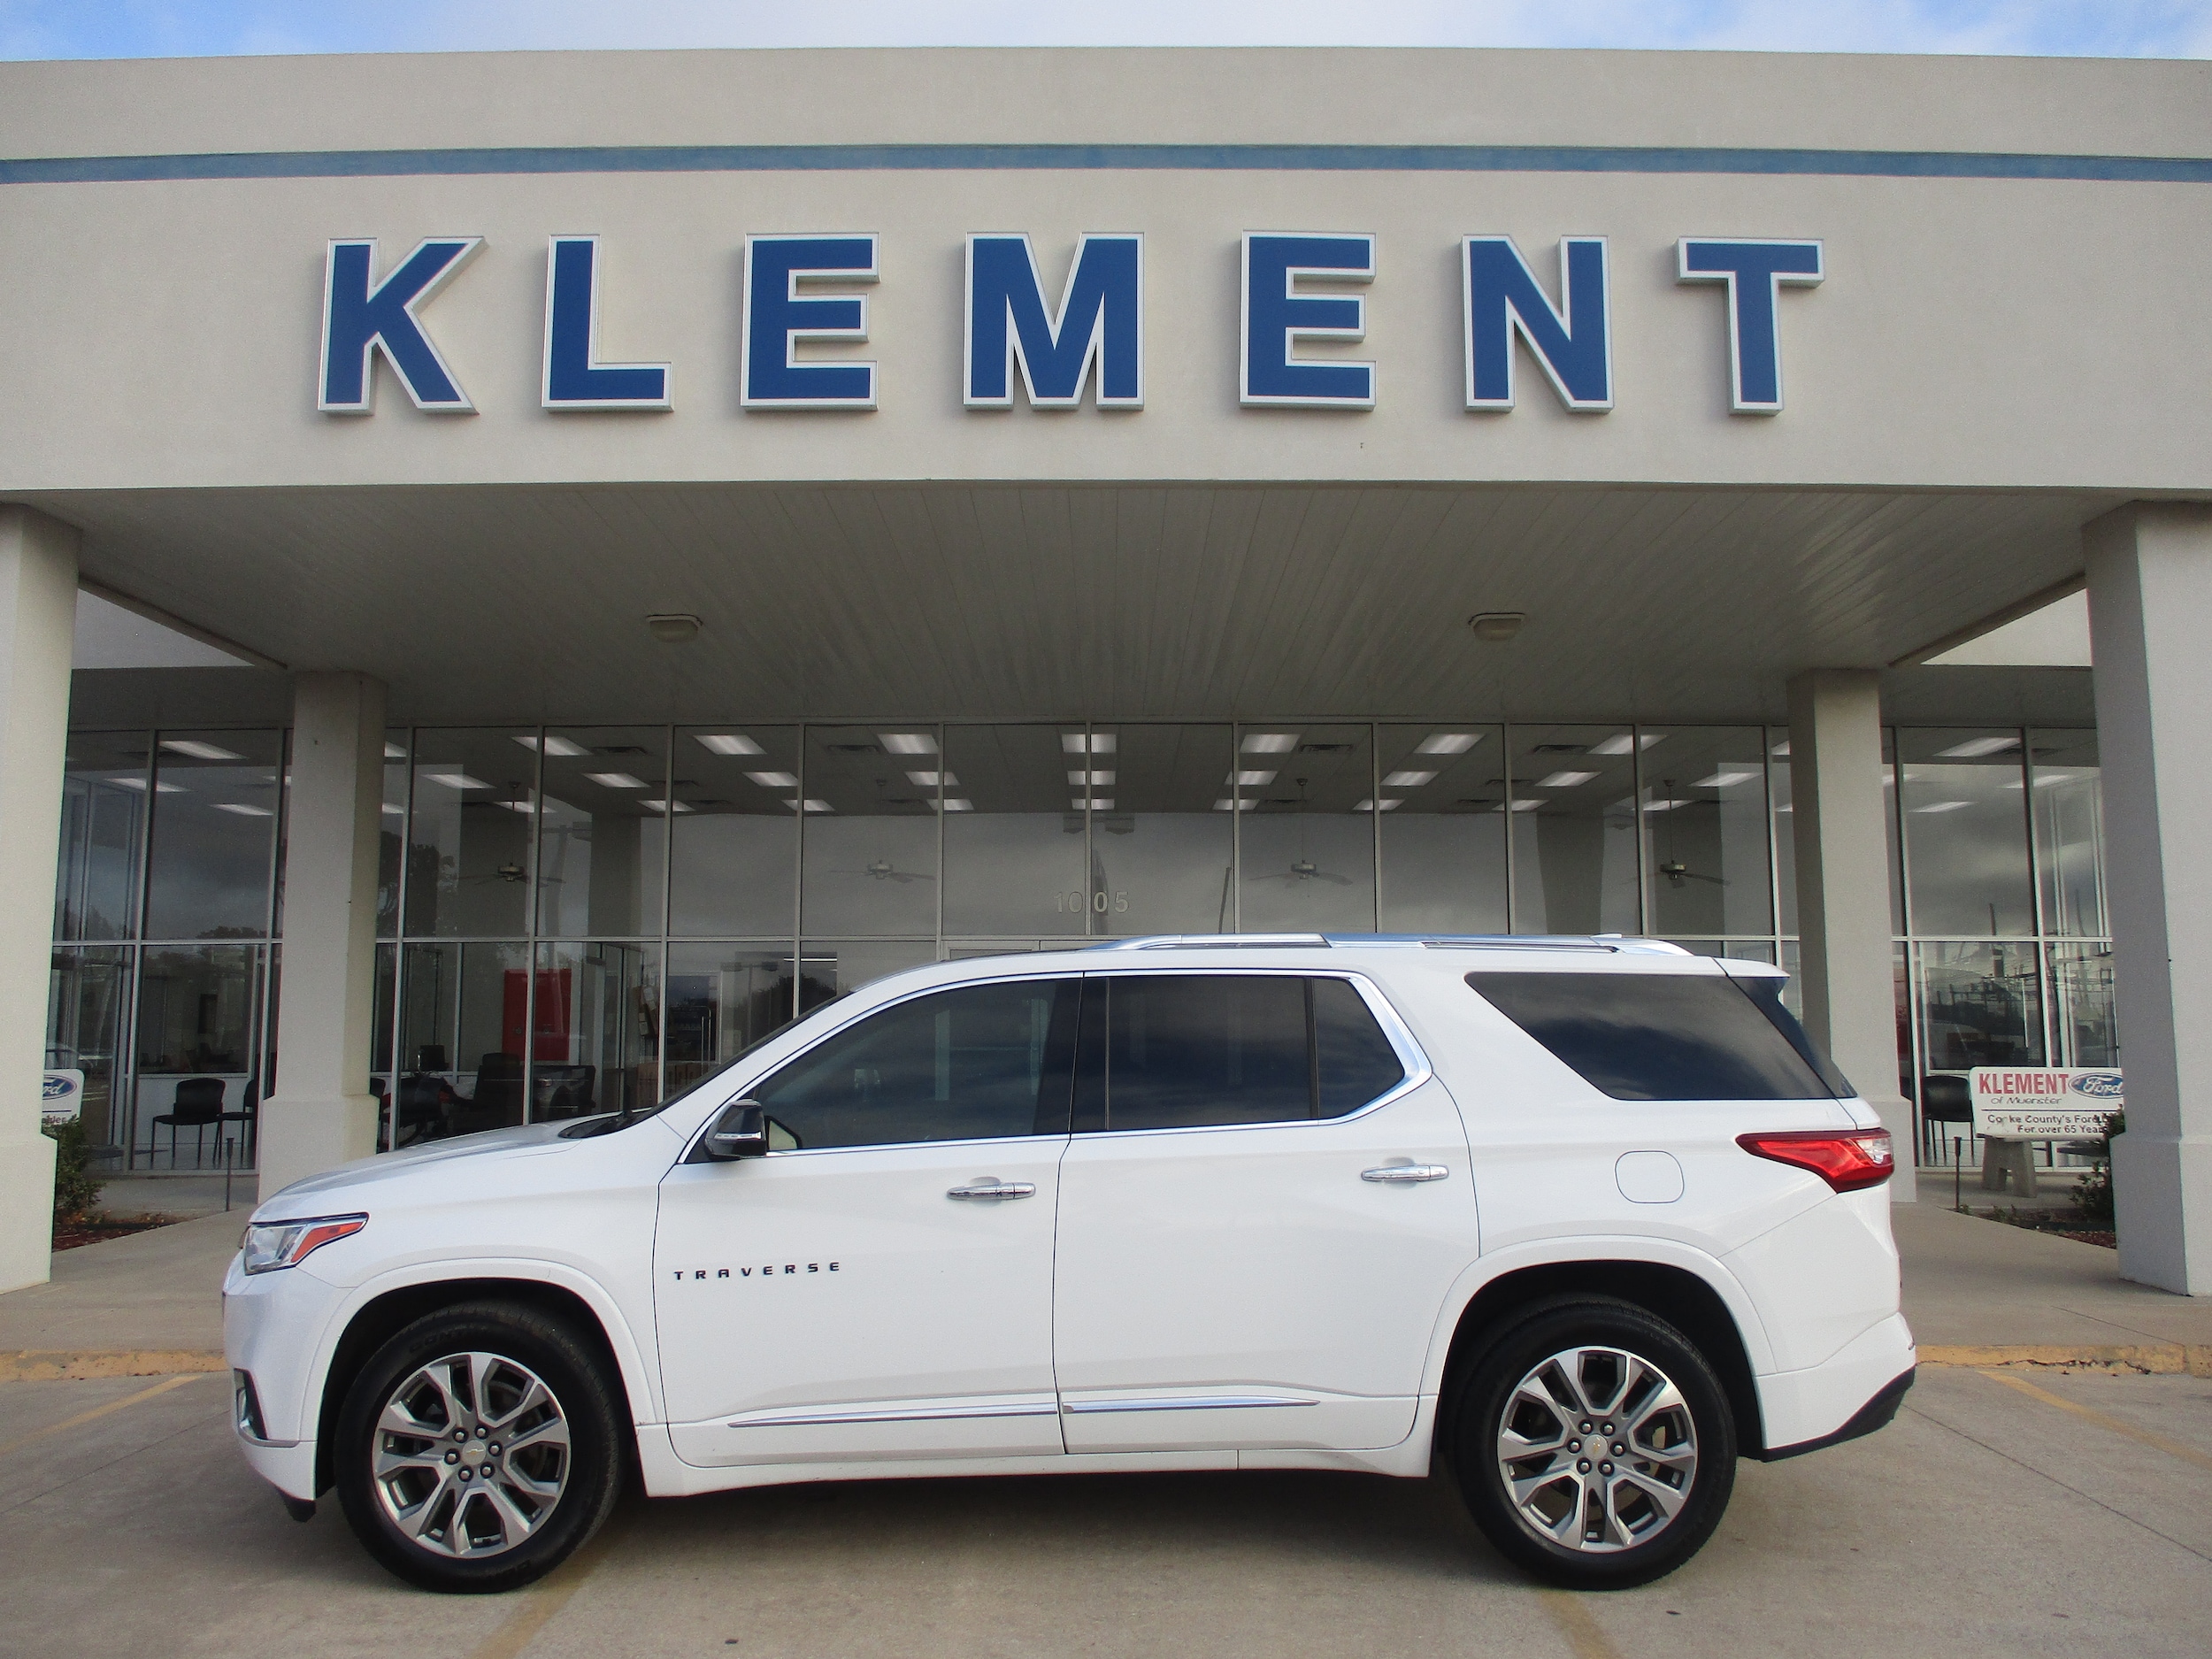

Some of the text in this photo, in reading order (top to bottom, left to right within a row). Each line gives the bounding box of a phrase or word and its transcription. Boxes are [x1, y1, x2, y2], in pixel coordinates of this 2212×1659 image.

[317, 231, 1825, 415] KLEMENT
[1054, 891, 1129, 913] 1005
[1978, 1073, 2069, 1094] KLEMENT
[2083, 1076, 2124, 1095] Ford
[2025, 1115, 2071, 1125] County's
[2064, 1125, 2076, 1133] 65
[674, 1262, 840, 1280] TRAVERSE
